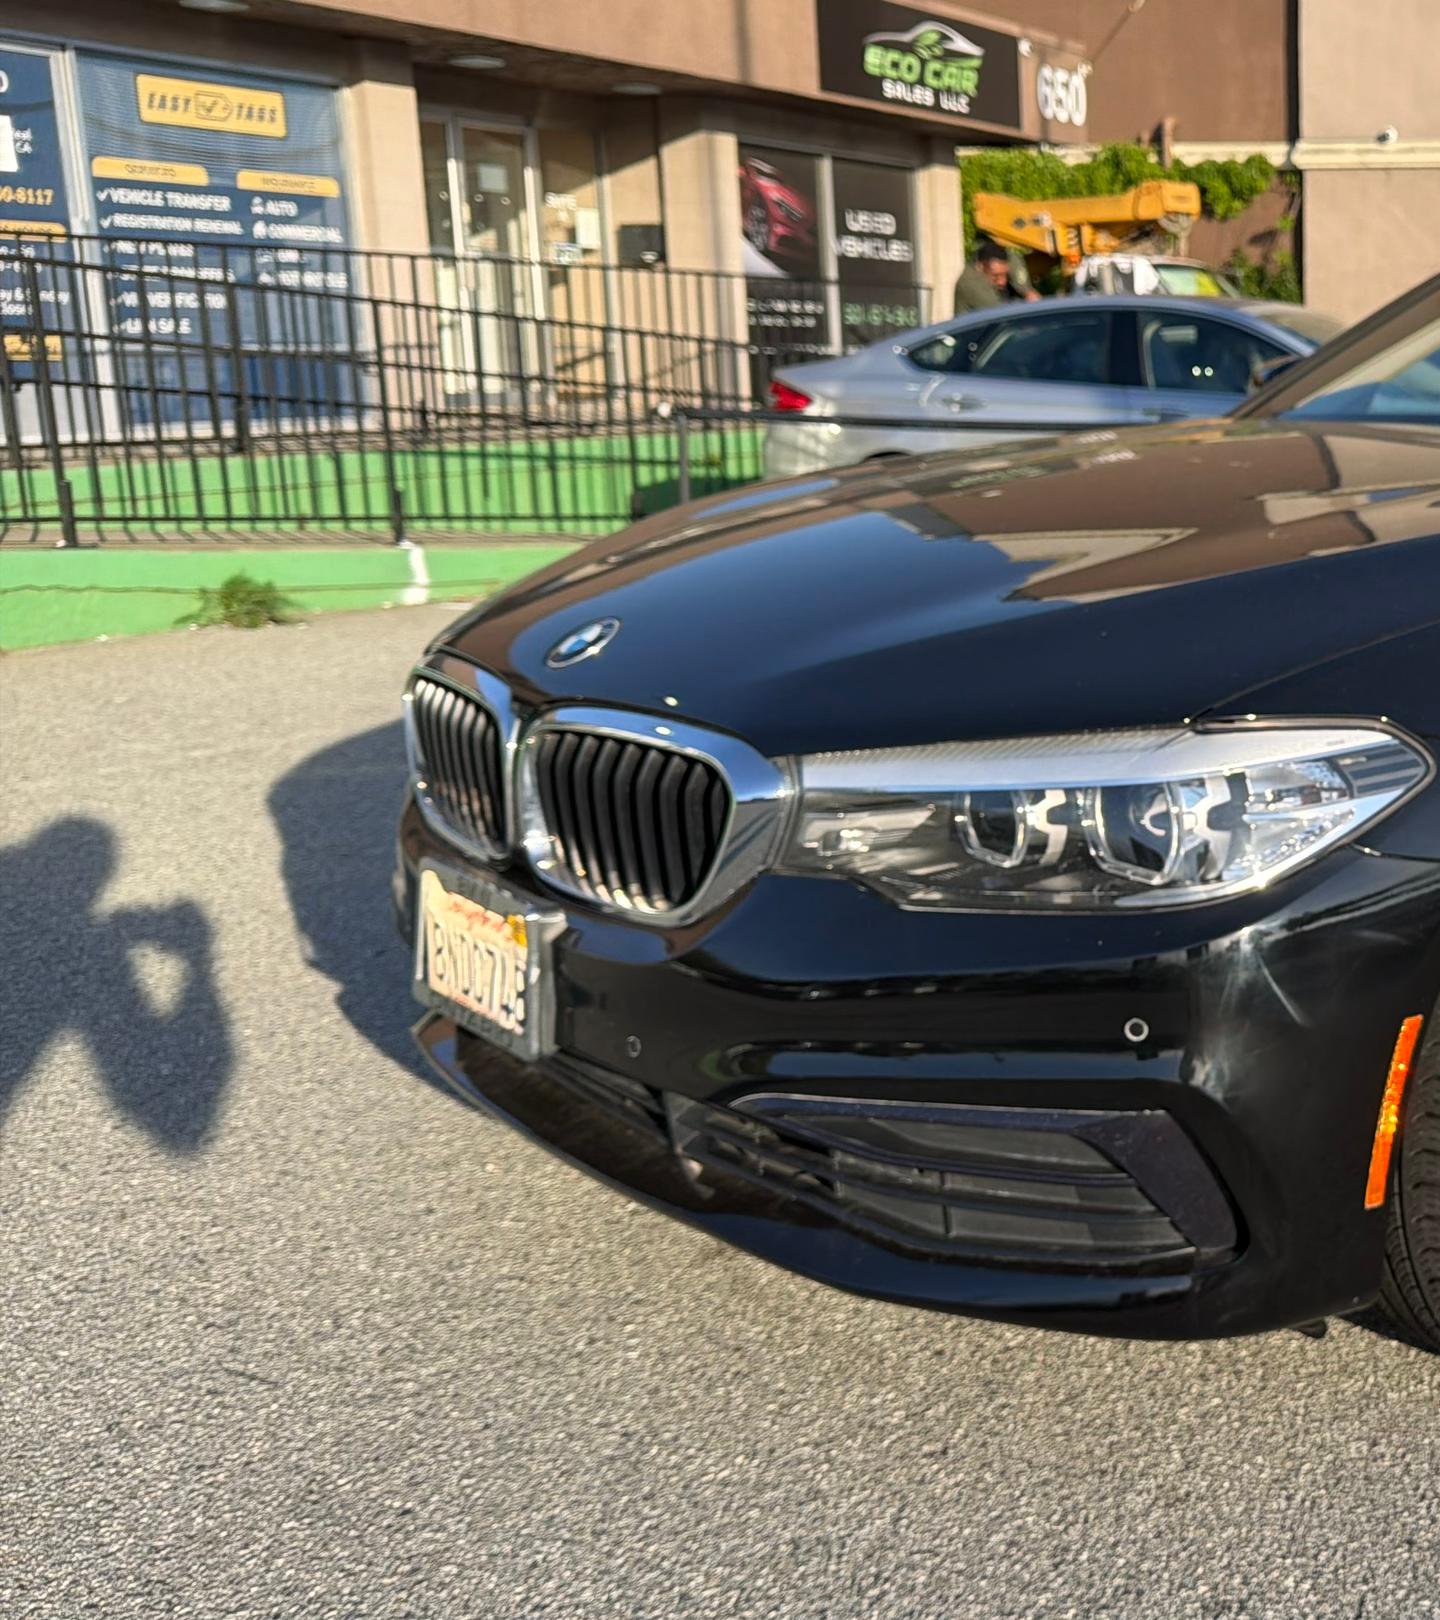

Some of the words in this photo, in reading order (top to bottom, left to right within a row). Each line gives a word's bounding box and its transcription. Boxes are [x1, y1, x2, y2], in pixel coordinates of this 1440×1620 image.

[863, 44, 922, 84] ECO
[923, 57, 983, 98] CAR
[881, 78, 936, 107] SALES
[939, 91, 971, 115] LLC
[1036, 62, 1087, 127] 650
[0, 185, 54, 206] 0-8117
[109, 187, 165, 207] VEHICLE
[165, 190, 232, 212] TRANSFER
[265, 199, 299, 217] AUTO
[112, 212, 192, 232] REGISTRATION
[193, 217, 244, 236] RENEWAL
[268, 223, 343, 243] COMMERCIAL
[844, 208, 897, 236] USED
